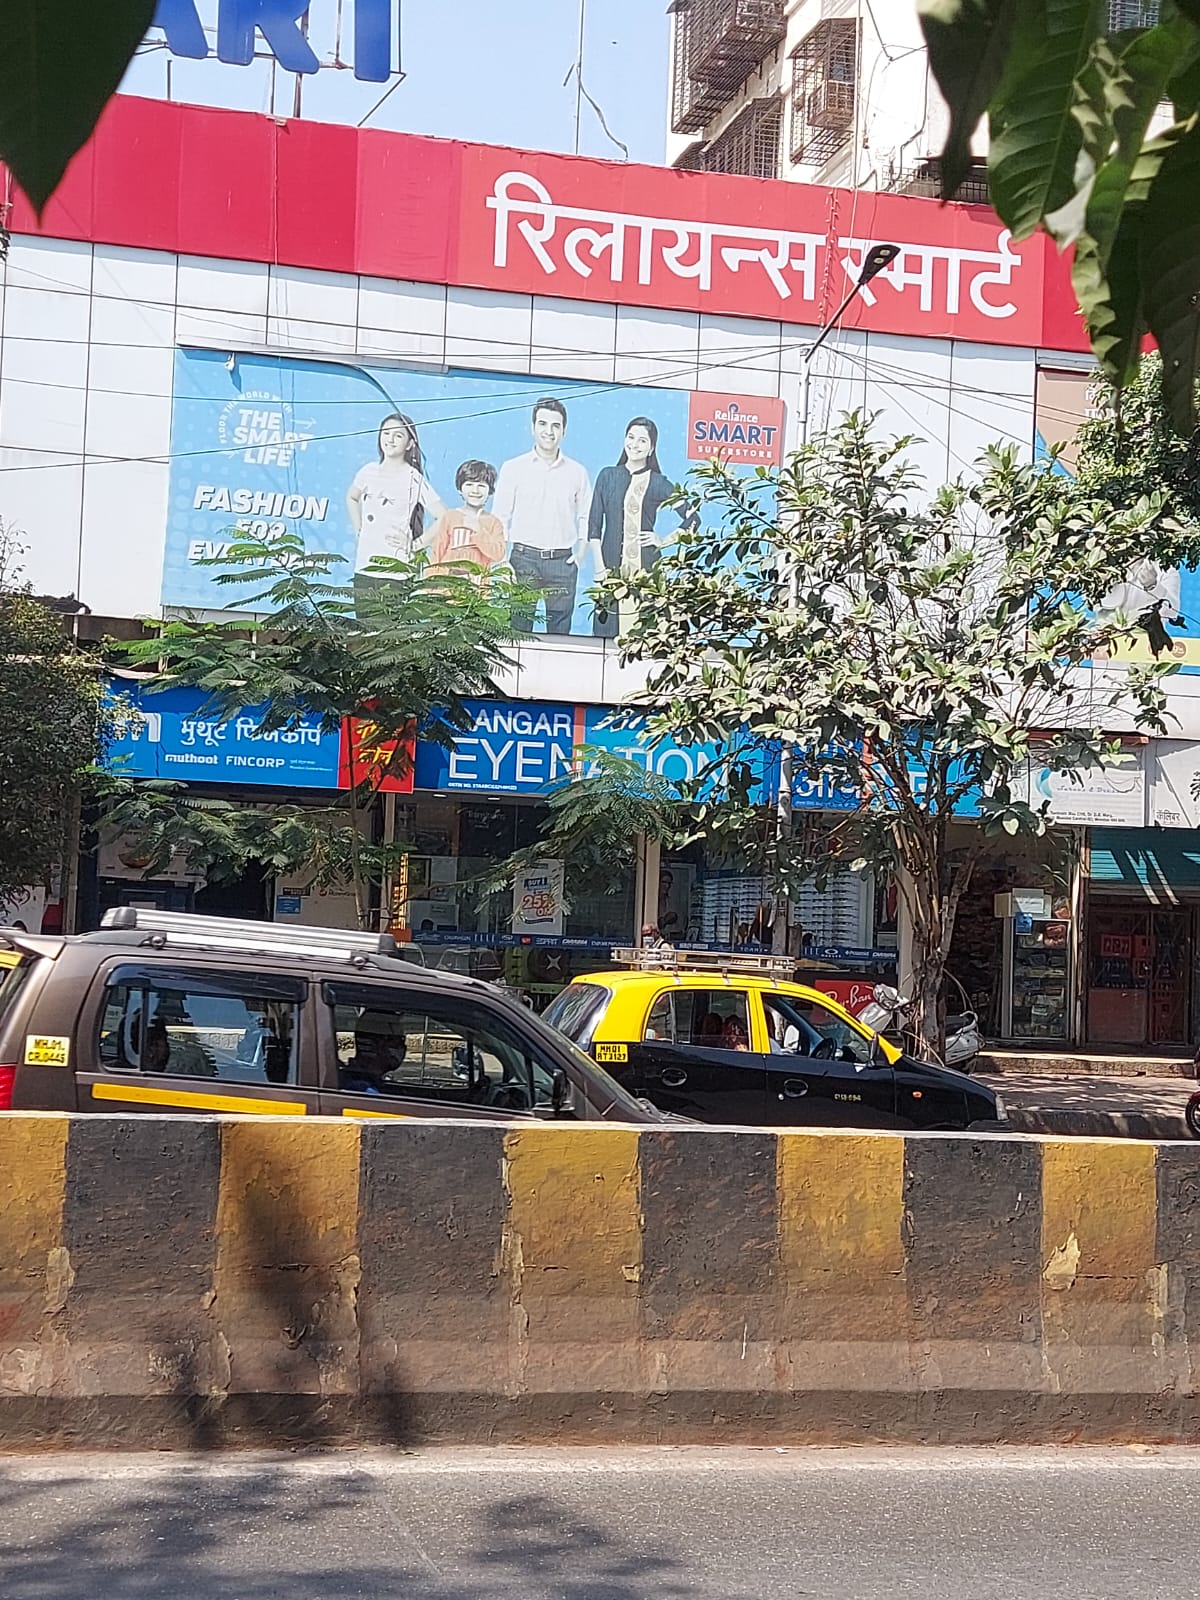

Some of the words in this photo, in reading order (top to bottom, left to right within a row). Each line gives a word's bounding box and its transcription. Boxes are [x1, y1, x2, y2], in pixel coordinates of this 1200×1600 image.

[486, 171, 826, 301] रिलायन्स
[239, 409, 282, 430] THE
[714, 409, 758, 423] Reliance
[233, 427, 314, 451] SMART
[694, 421, 777, 446] SMART
[243, 447, 292, 467] LIFE
[697, 445, 773, 458] SUPERSTORE
[193, 485, 329, 521] FASHION
[165, 753, 218, 764] muthoot
[226, 756, 285, 767] FINCORP
